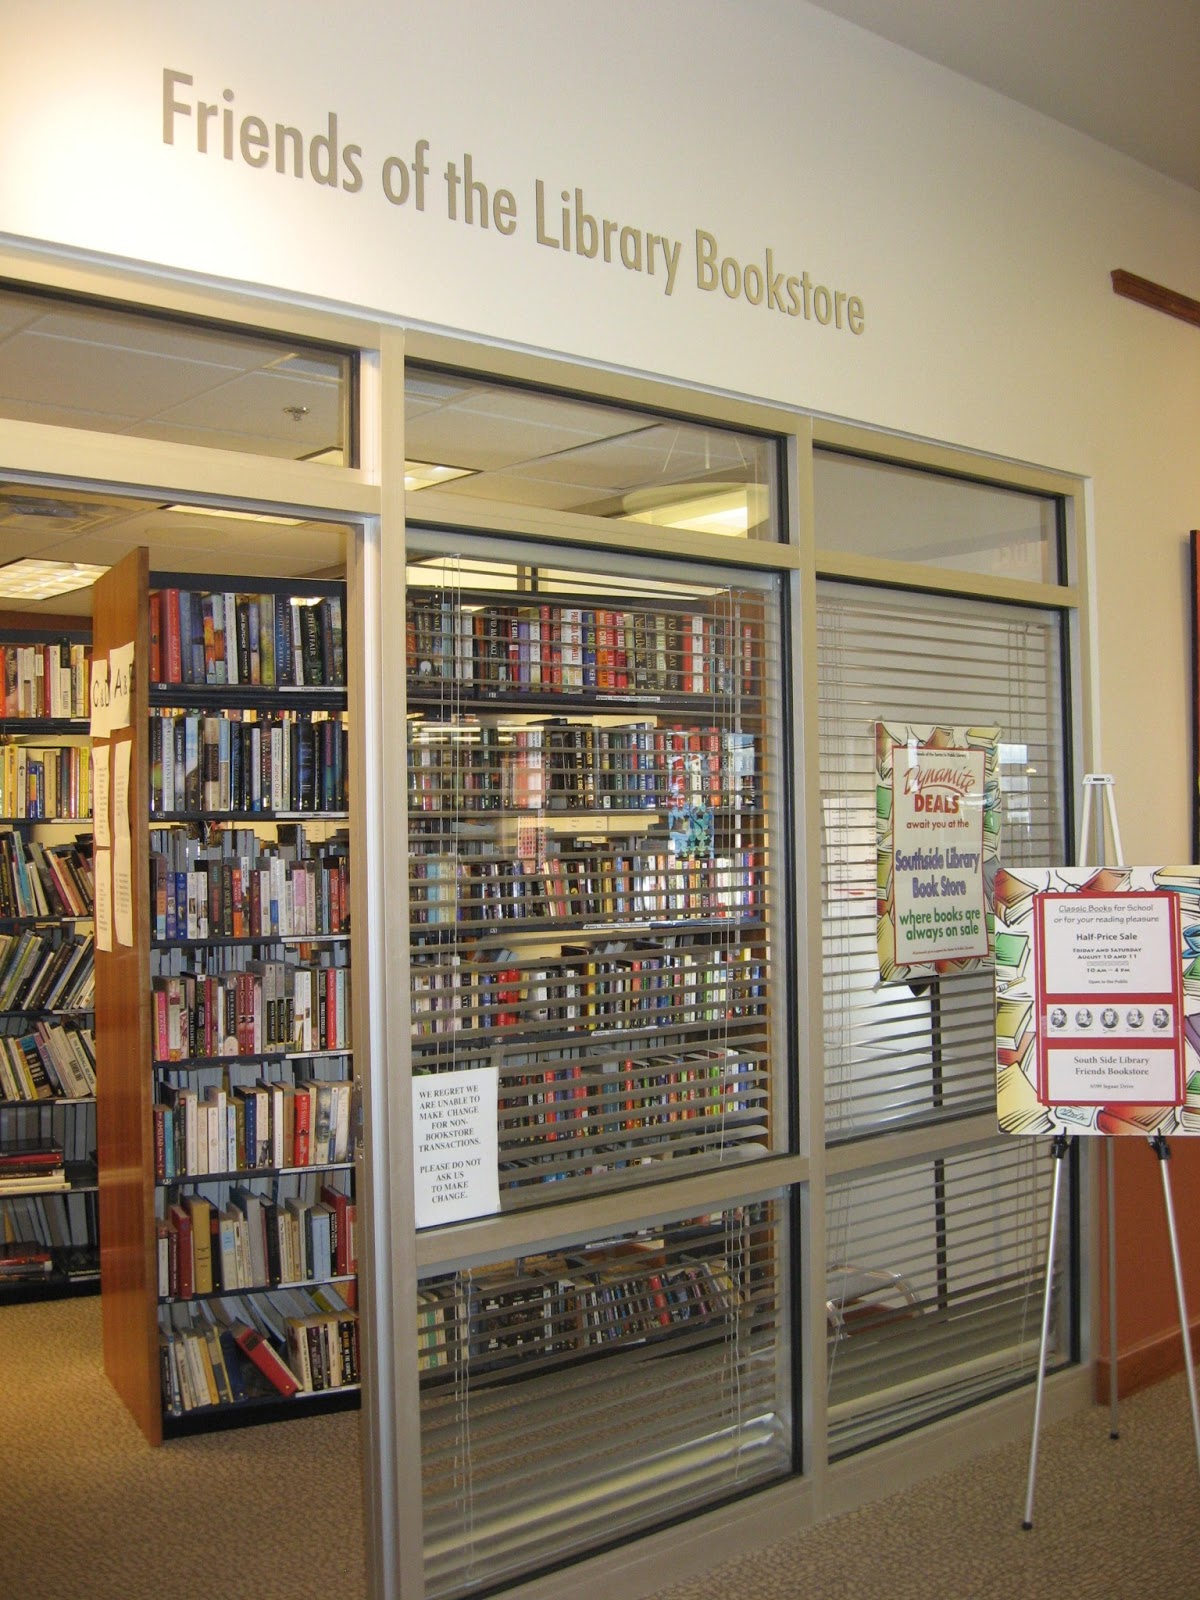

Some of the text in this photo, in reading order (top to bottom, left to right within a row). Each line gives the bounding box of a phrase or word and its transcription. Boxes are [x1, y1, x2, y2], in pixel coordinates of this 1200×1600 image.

[163, 68, 865, 335] Friends of the Library Bookstore
[511, 627, 519, 639] CHIL
[571, 611, 579, 661] PATCIA CORWELL
[599, 631, 607, 652] CRAS
[904, 765, 976, 795] Dynamite
[914, 794, 960, 814] DEALS
[906, 818, 969, 831] await you at the
[895, 846, 980, 874] Southside Library
[912, 874, 967, 899] Book Store
[1059, 904, 1154, 913] Classic Books for School
[899, 906, 980, 925] where books are
[1076, 917, 1094, 925] your
[1095, 916, 1124, 924] reading
[1126, 915, 1159, 925] pleasure
[906, 920, 979, 943] always on sale
[1076, 932, 1138, 941] Half-Price Sale
[1074, 1056, 1149, 1065] South Side Library
[1075, 1067, 1149, 1075] Friends Bookstore
[419, 1084, 479, 1099] WE REGRET WE
[419, 1095, 481, 1110] ARE UNABLE TO
[419, 1106, 479, 1120] MAKE CHANGE
[431, 1118, 469, 1130] FOR NON-
[425, 1128, 474, 1141] BOOKSTORE
[419, 1139, 481, 1152] TRANSACTIONS.
[420, 1158, 482, 1174] PLEASE DO NOT
[436, 1171, 465, 1182] ASK US
[431, 1181, 469, 1193] TO MAKE
[431, 1191, 468, 1204] CHANGE.
